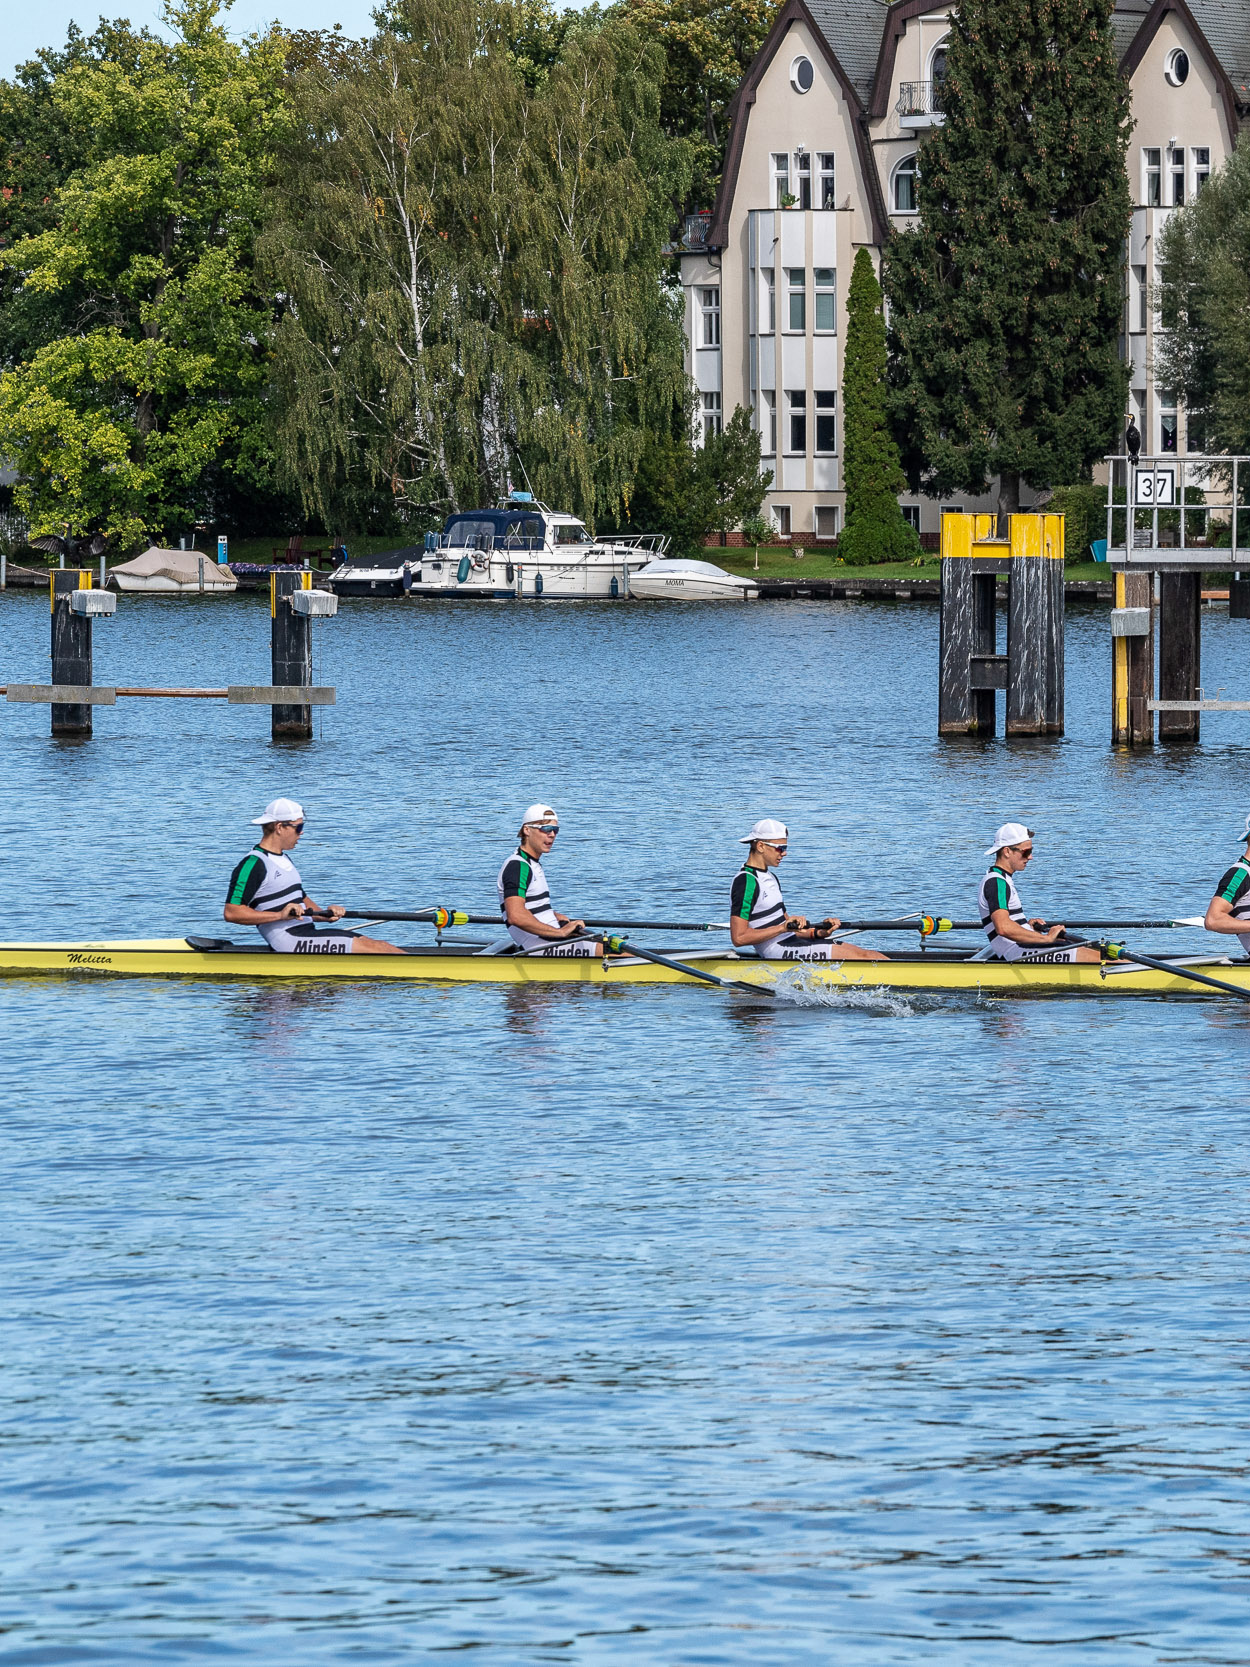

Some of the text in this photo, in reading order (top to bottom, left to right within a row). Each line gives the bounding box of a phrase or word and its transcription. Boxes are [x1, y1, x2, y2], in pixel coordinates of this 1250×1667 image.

[1142, 478, 1167, 498] 37
[293, 940, 346, 953] Minden
[543, 944, 590, 957] Minden
[67, 953, 112, 963] Melitta
